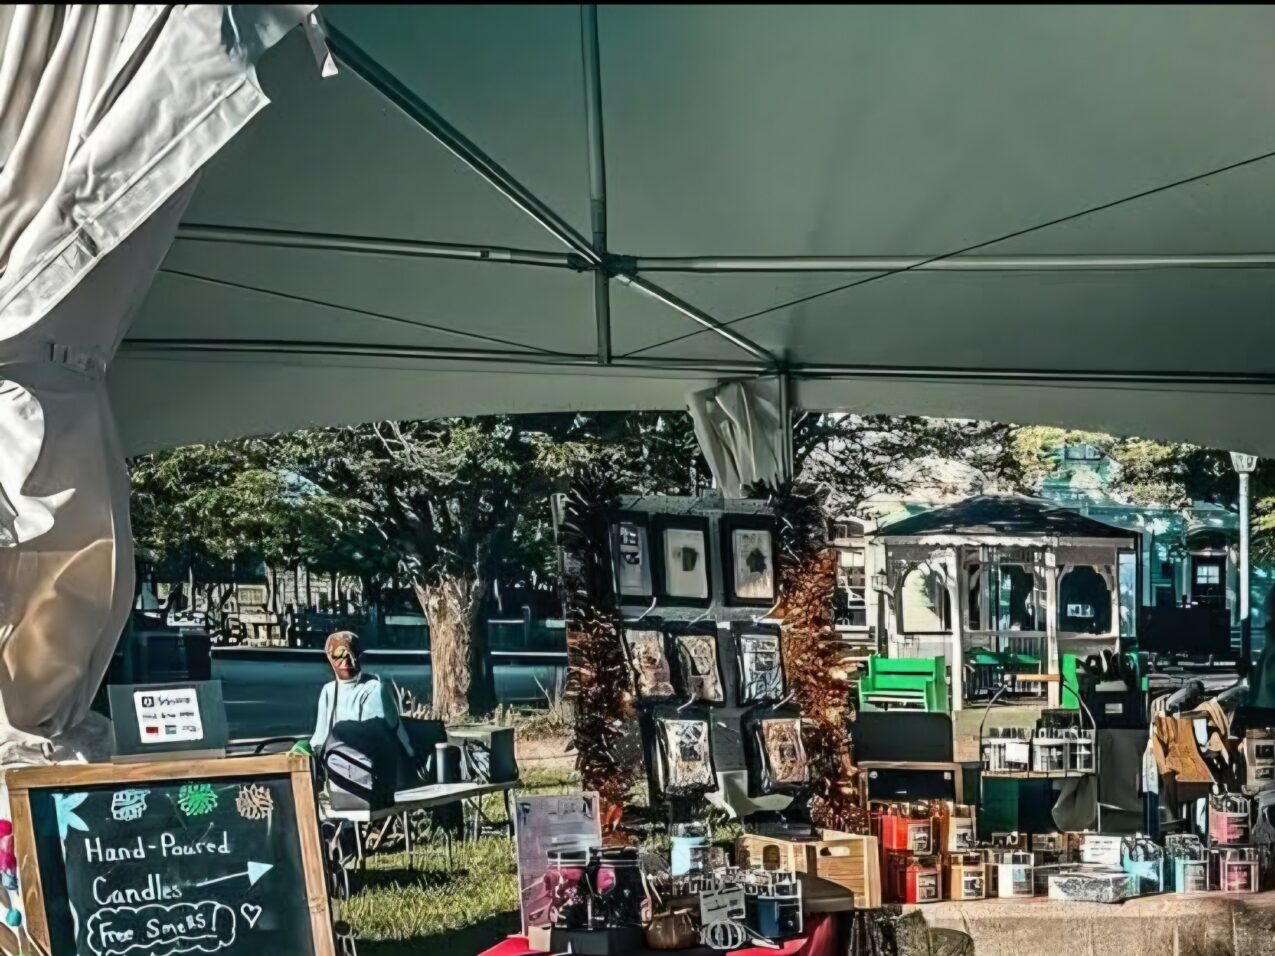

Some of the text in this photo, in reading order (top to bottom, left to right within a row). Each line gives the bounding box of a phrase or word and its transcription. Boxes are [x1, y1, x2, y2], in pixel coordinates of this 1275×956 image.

[84, 830, 231, 863] Hand-Poured
[92, 873, 183, 906] Candles
[99, 921, 134, 948] Free
